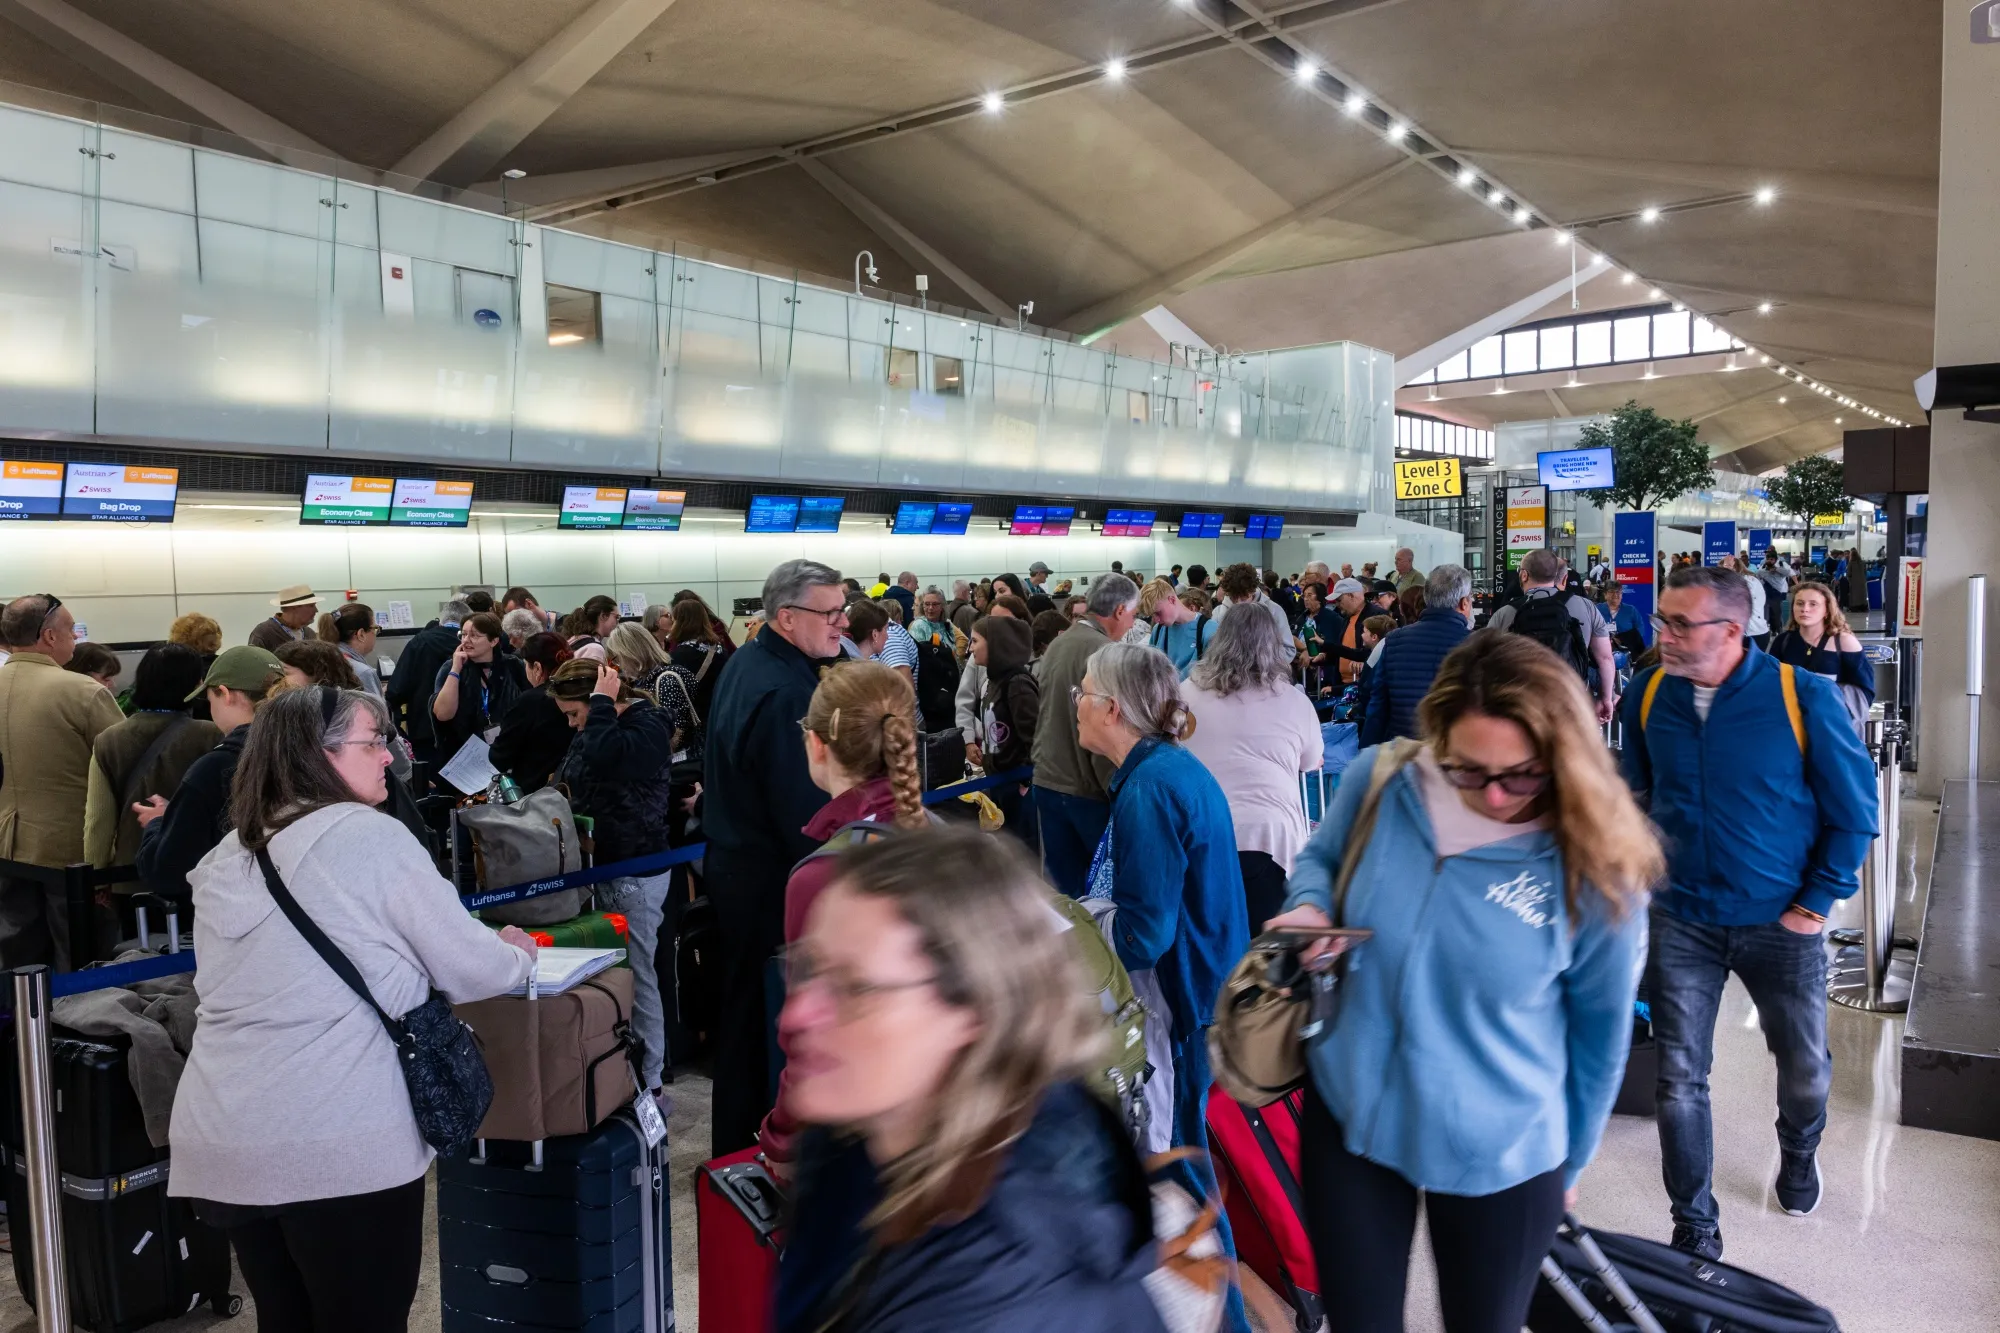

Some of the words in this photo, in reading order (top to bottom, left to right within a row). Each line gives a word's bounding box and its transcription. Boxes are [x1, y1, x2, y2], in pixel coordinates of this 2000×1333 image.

[22, 467, 58, 475] Lufthansa
[1402, 462, 1440, 478] Level
[1444, 461, 1452, 475] 3
[1404, 482, 1444, 496] Zone
[1444, 480, 1452, 494] C
[0, 501, 23, 510] Drop
[100, 502, 117, 512] Bag
[119, 504, 141, 512] Drop
[320, 509, 353, 517] Economy
[407, 511, 436, 519] Economy
[1094, 841, 1104, 862] TRAVEL
[472, 890, 516, 906] Lufthansa
[538, 879, 564, 892] SWISS
[129, 1168, 158, 1181] MERKUR
[129, 1174, 158, 1187] SERVICE
